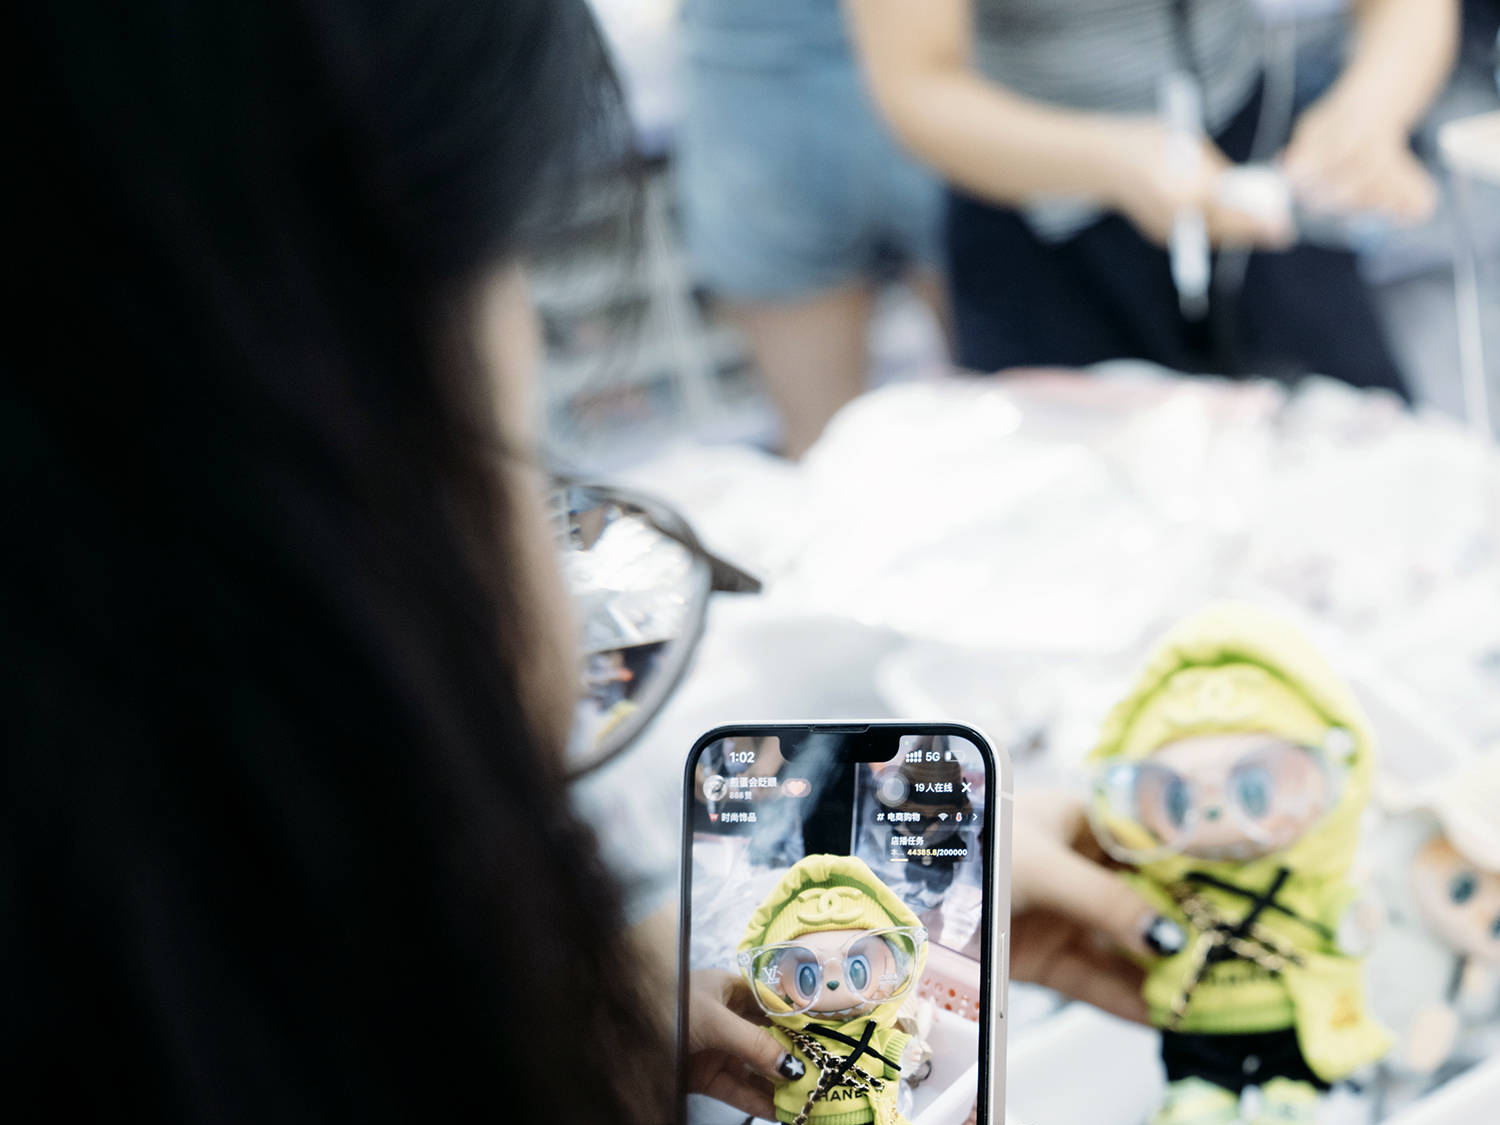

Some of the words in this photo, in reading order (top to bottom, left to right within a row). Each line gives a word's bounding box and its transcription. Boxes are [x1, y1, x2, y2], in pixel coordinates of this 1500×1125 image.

[729, 752, 755, 763] 1:02
[925, 752, 940, 762] 5G
[915, 783, 953, 793] 19人在线
